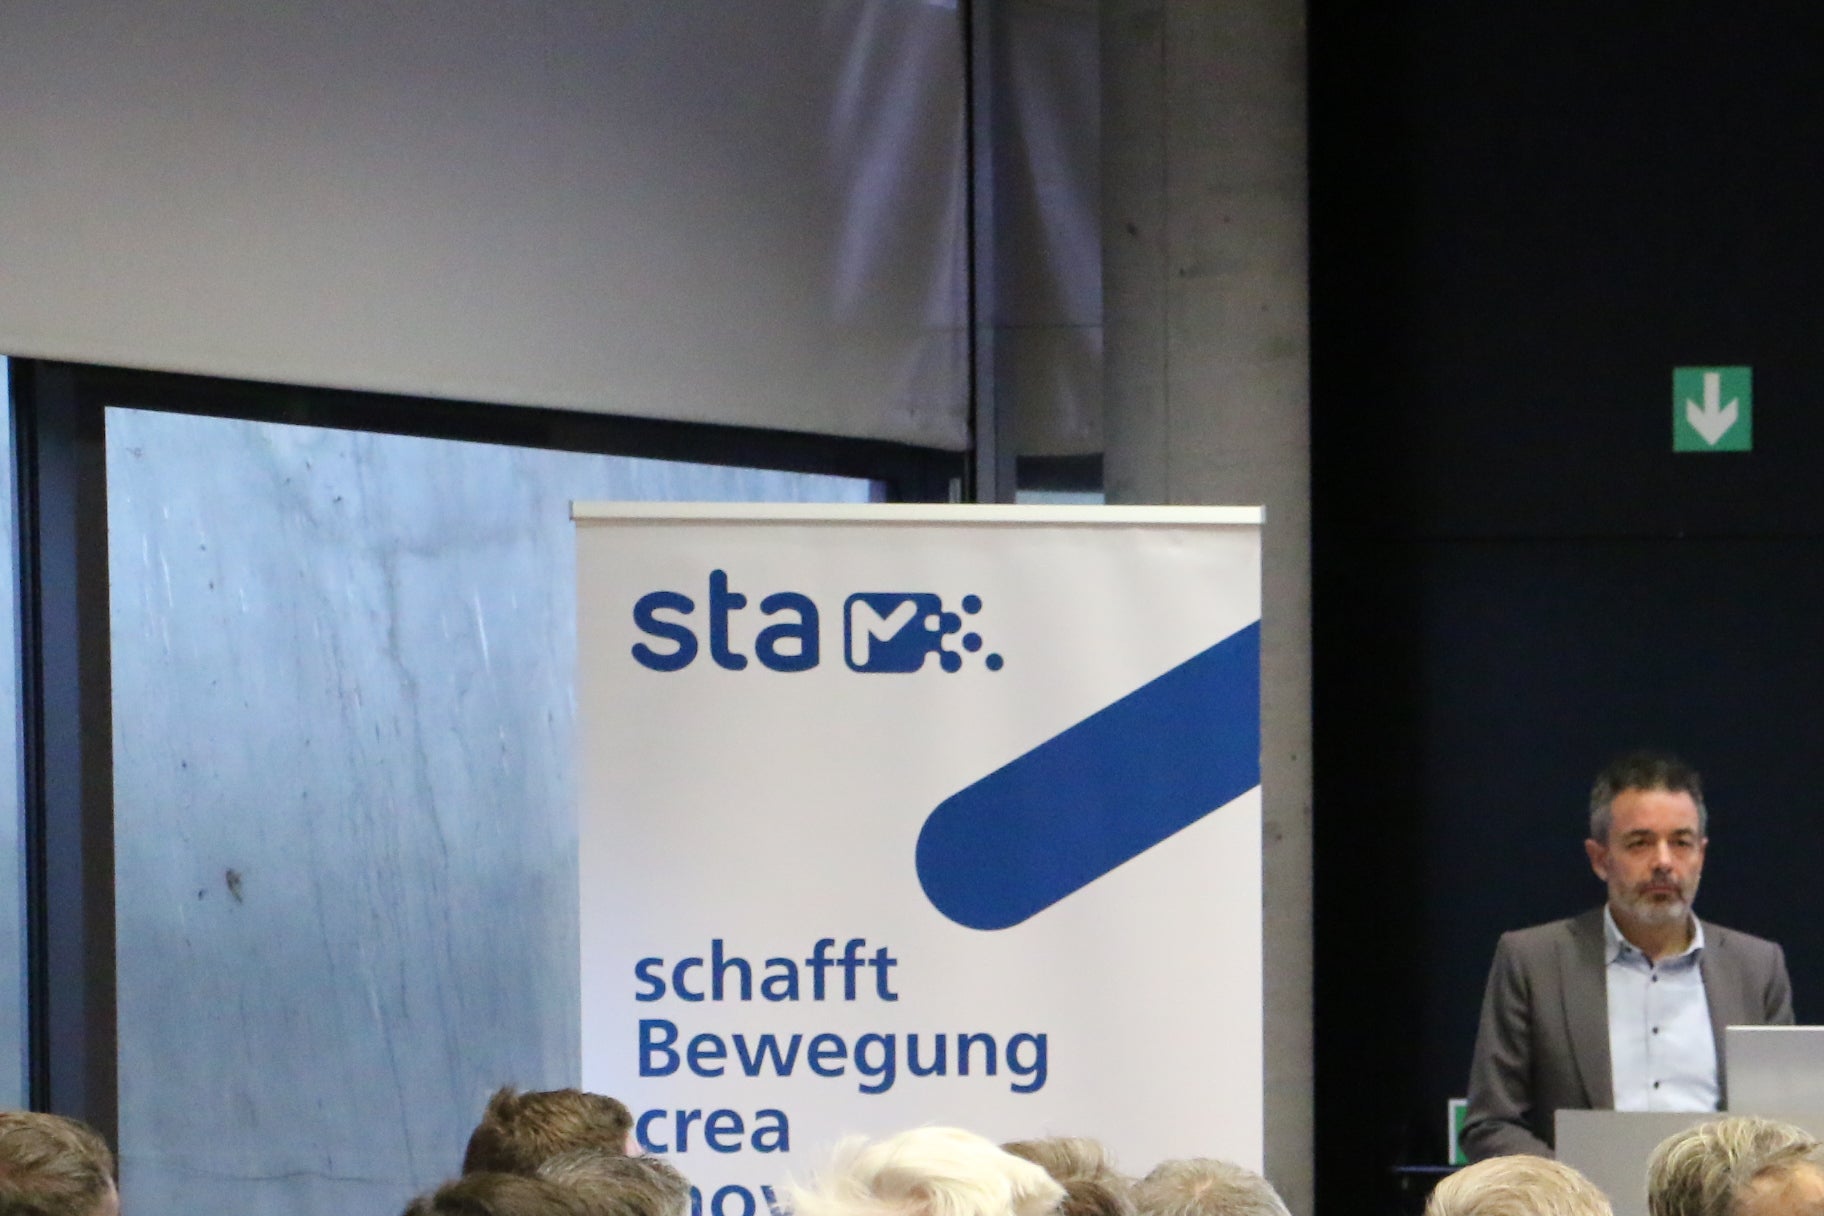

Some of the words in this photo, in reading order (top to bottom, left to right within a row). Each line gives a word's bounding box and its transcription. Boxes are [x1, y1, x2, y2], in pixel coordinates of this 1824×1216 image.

[630, 568, 821, 673] sta
[634, 938, 899, 1002] schafft
[637, 1018, 1049, 1095] Bewegung
[636, 1108, 790, 1153] crea
